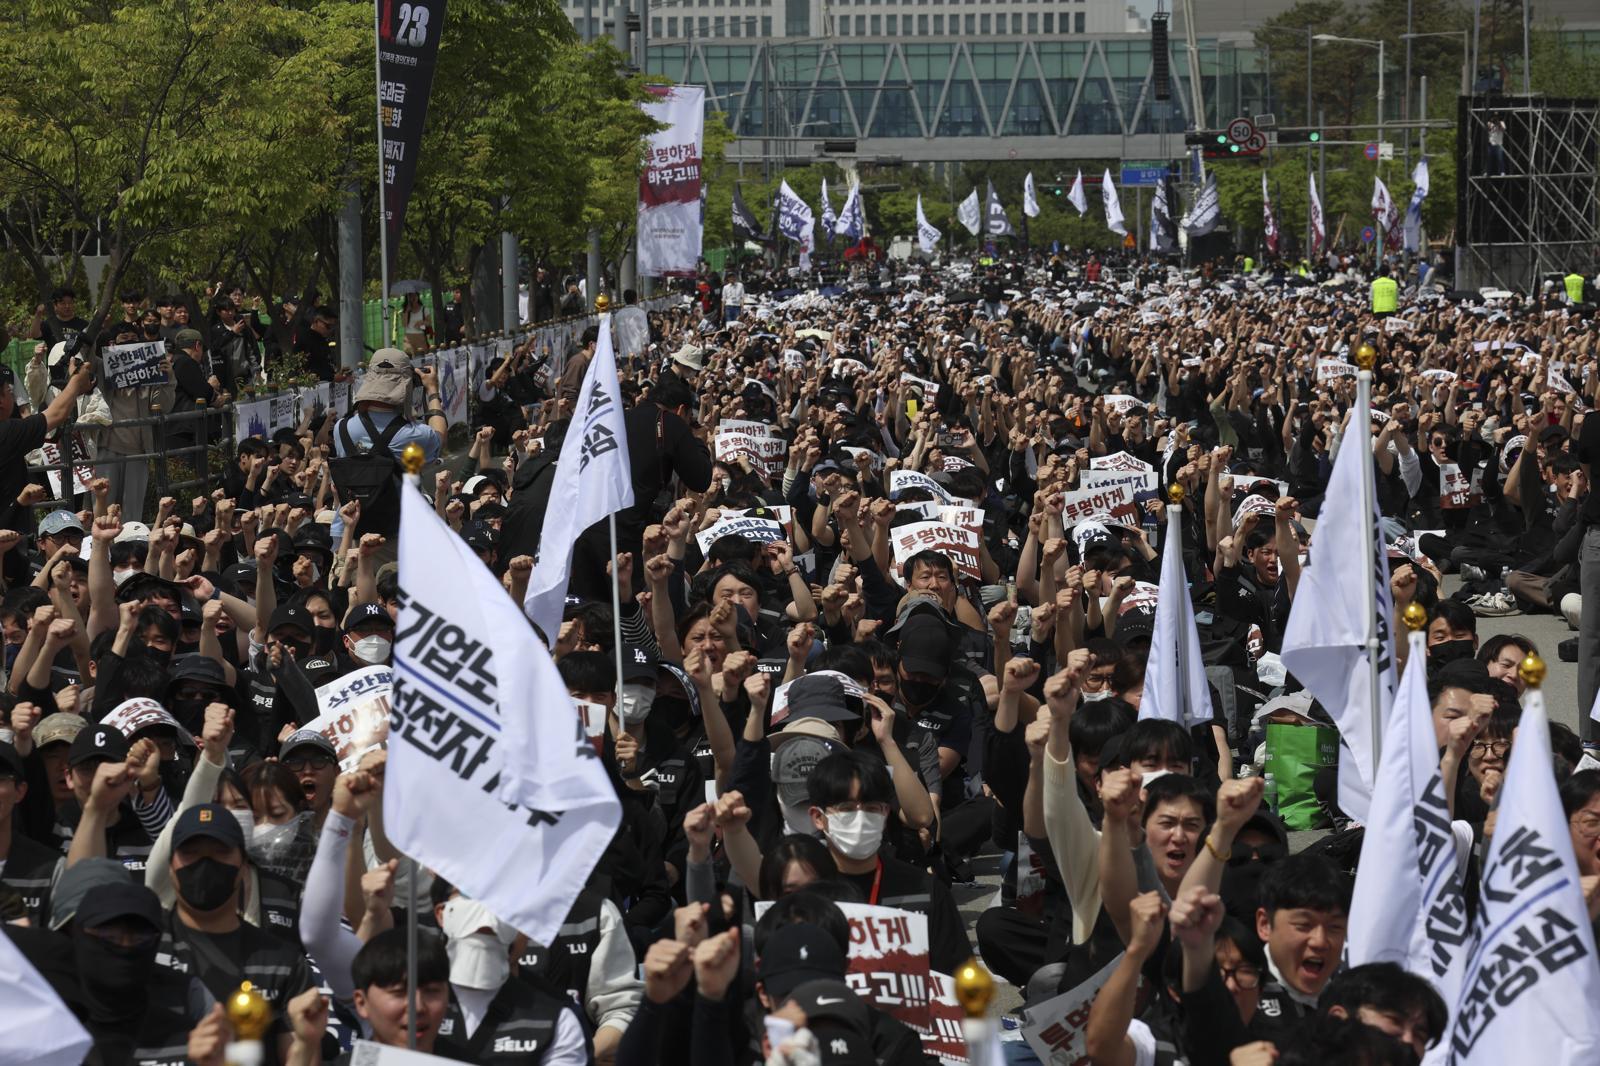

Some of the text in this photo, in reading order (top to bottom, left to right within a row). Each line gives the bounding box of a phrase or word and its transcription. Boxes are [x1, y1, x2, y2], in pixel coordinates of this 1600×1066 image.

[1233, 126, 1249, 137] 50
[648, 165, 699, 185] 바꾸고!!!
[107, 344, 157, 369] 상한폐지
[763, 442, 784, 455] 하게
[1065, 487, 1126, 517] 투명하게
[900, 527, 969, 551] 투명하게
[366, 605, 379, 614] NY
[394, 588, 498, 706] 기업노
[634, 648, 647, 663] LA
[95, 732, 105, 747] C
[123, 861, 146, 870] SEL
[847, 916, 911, 950] 하게
[494, 1039, 537, 1052] SELU
